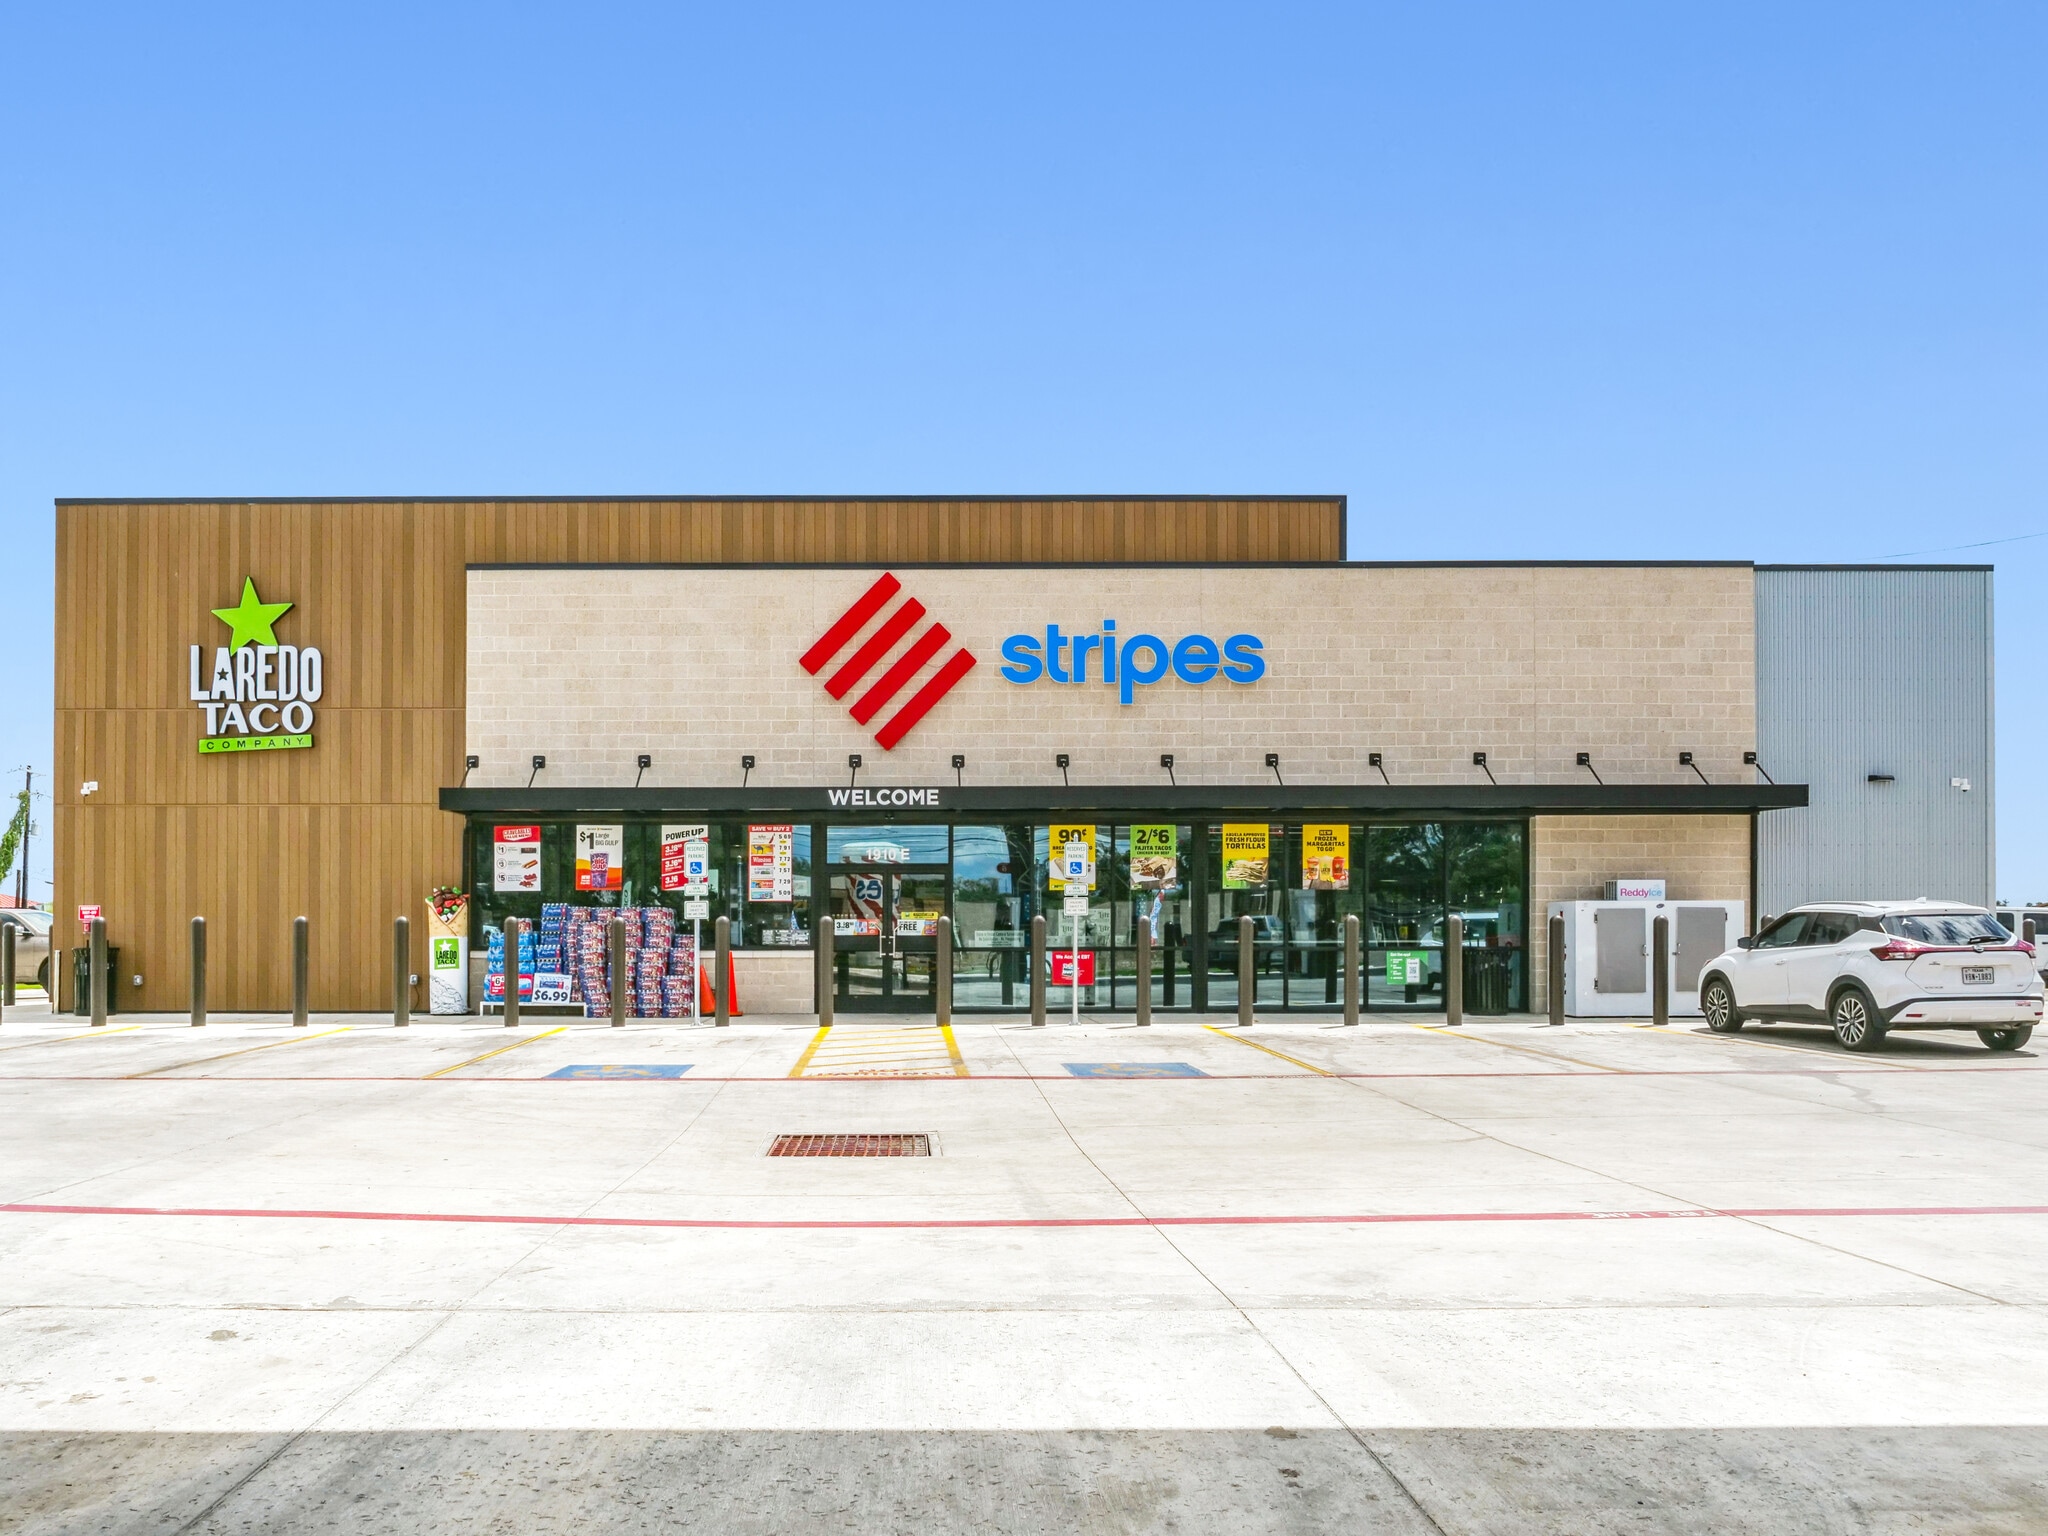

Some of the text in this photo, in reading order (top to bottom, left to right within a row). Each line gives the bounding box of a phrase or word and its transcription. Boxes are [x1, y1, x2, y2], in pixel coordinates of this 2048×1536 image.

[1000, 619, 1266, 705] stripes
[190, 645, 322, 703] LAREDO
[198, 700, 314, 735] TACO
[206, 737, 304, 750] COMPANY
[828, 789, 939, 806] WELCOME
[579, 831, 594, 849] $1
[665, 828, 704, 840] POWER UP
[1136, 829, 1169, 844] 2/$6
[866, 848, 910, 860] 1910 E
[436, 950, 458, 960] LAREDO
[534, 989, 569, 1001] $6.99
